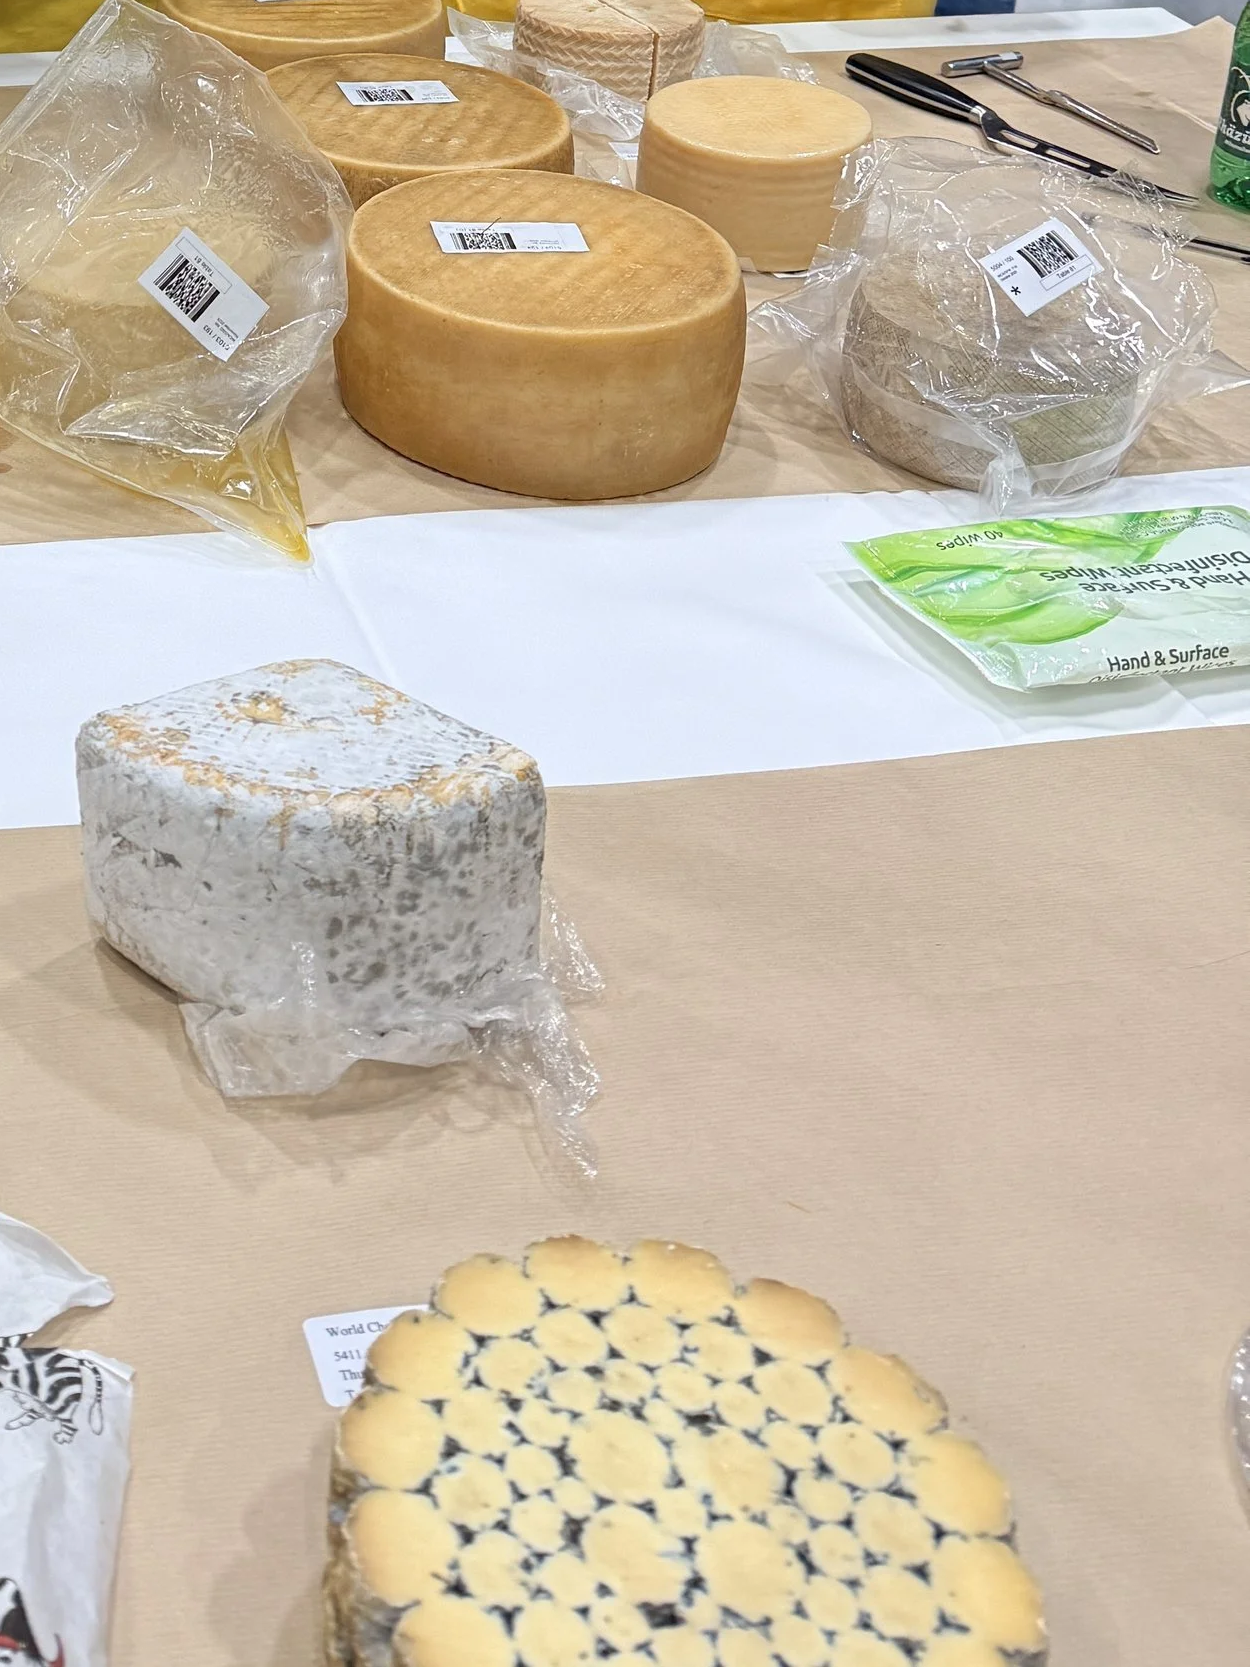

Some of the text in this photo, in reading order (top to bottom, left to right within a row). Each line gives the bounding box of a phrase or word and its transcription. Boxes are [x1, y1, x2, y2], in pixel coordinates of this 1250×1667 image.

[1055, 269, 1070, 279] Table
[936, 530, 1003, 551] 40 wipes
[1039, 550, 1250, 582] Disinfectant Wipes
[1078, 570, 1250, 594] Hand & Surface
[1107, 644, 1230, 672] Hand & Surface
[325, 1324, 365, 1337] World
[334, 1349, 362, 1362] 5411
